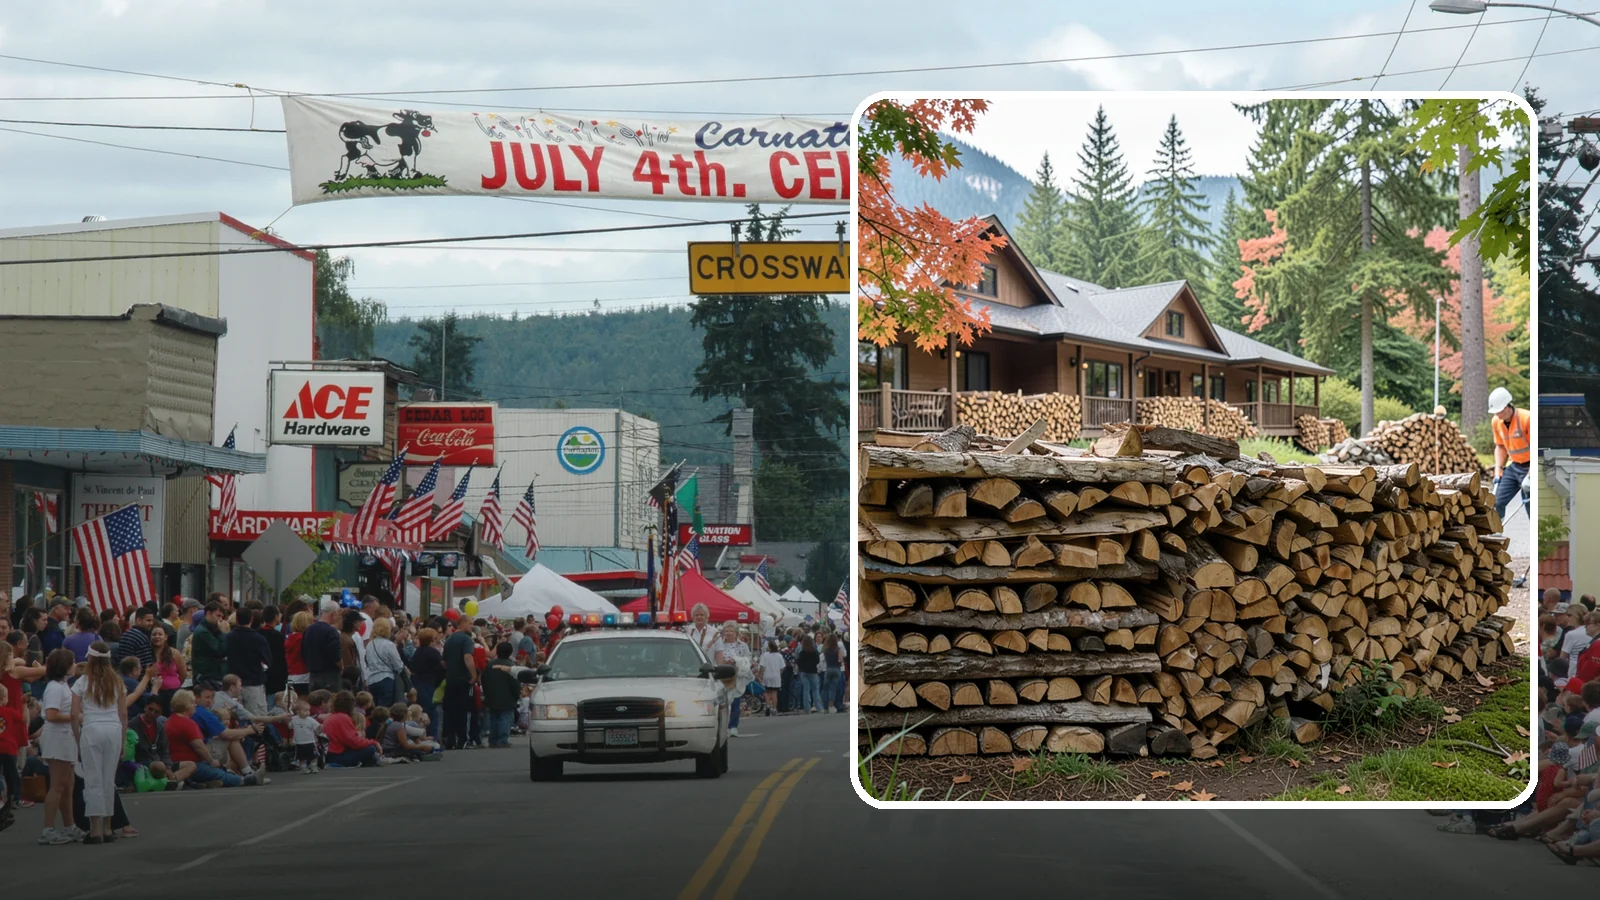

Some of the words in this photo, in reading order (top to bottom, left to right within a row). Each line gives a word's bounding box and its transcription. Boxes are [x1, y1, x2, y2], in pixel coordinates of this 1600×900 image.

[694, 121, 850, 150] Carnat
[481, 141, 605, 192] JULY
[632, 150, 746, 197] 4th.
[696, 254, 850, 279] CROSSWA
[282, 380, 374, 420] ACE
[405, 409, 452, 421] CEDAR
[461, 409, 485, 421] LOG
[283, 421, 371, 437] Hardware
[83, 485, 93, 494] St.
[95, 485, 124, 494] Vincent
[126, 486, 135, 494] de
[137, 486, 155, 495] Paul
[688, 526, 741, 535] CRNATION
[699, 535, 730, 543] GLASS
